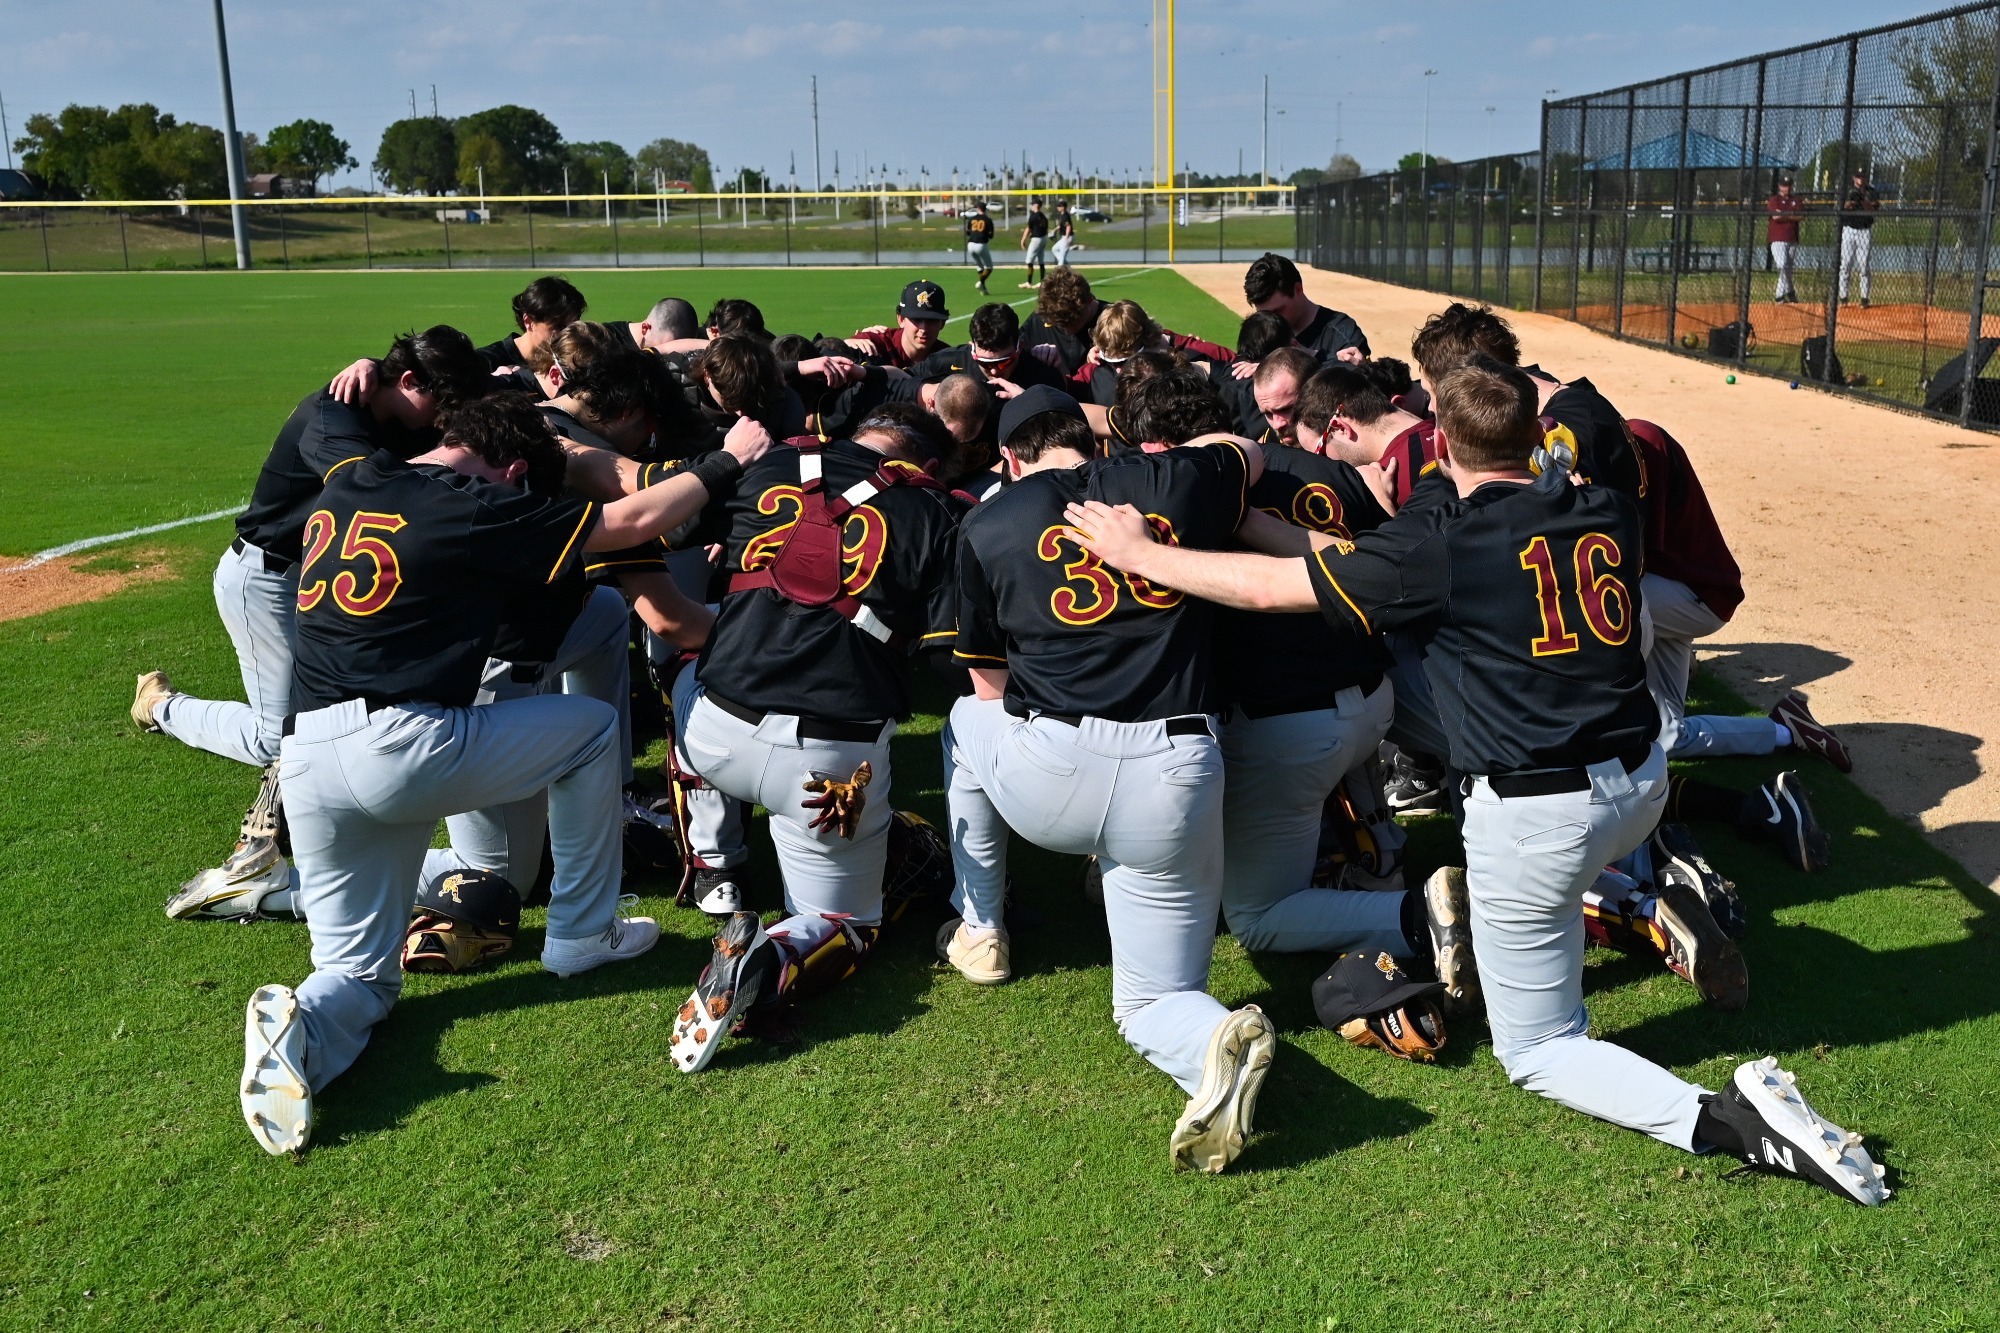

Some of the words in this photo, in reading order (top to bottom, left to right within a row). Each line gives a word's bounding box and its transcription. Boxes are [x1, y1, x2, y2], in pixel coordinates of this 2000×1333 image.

[970, 218, 985, 232] 20
[296, 509, 409, 616] 25
[1519, 532, 1632, 657] 16
